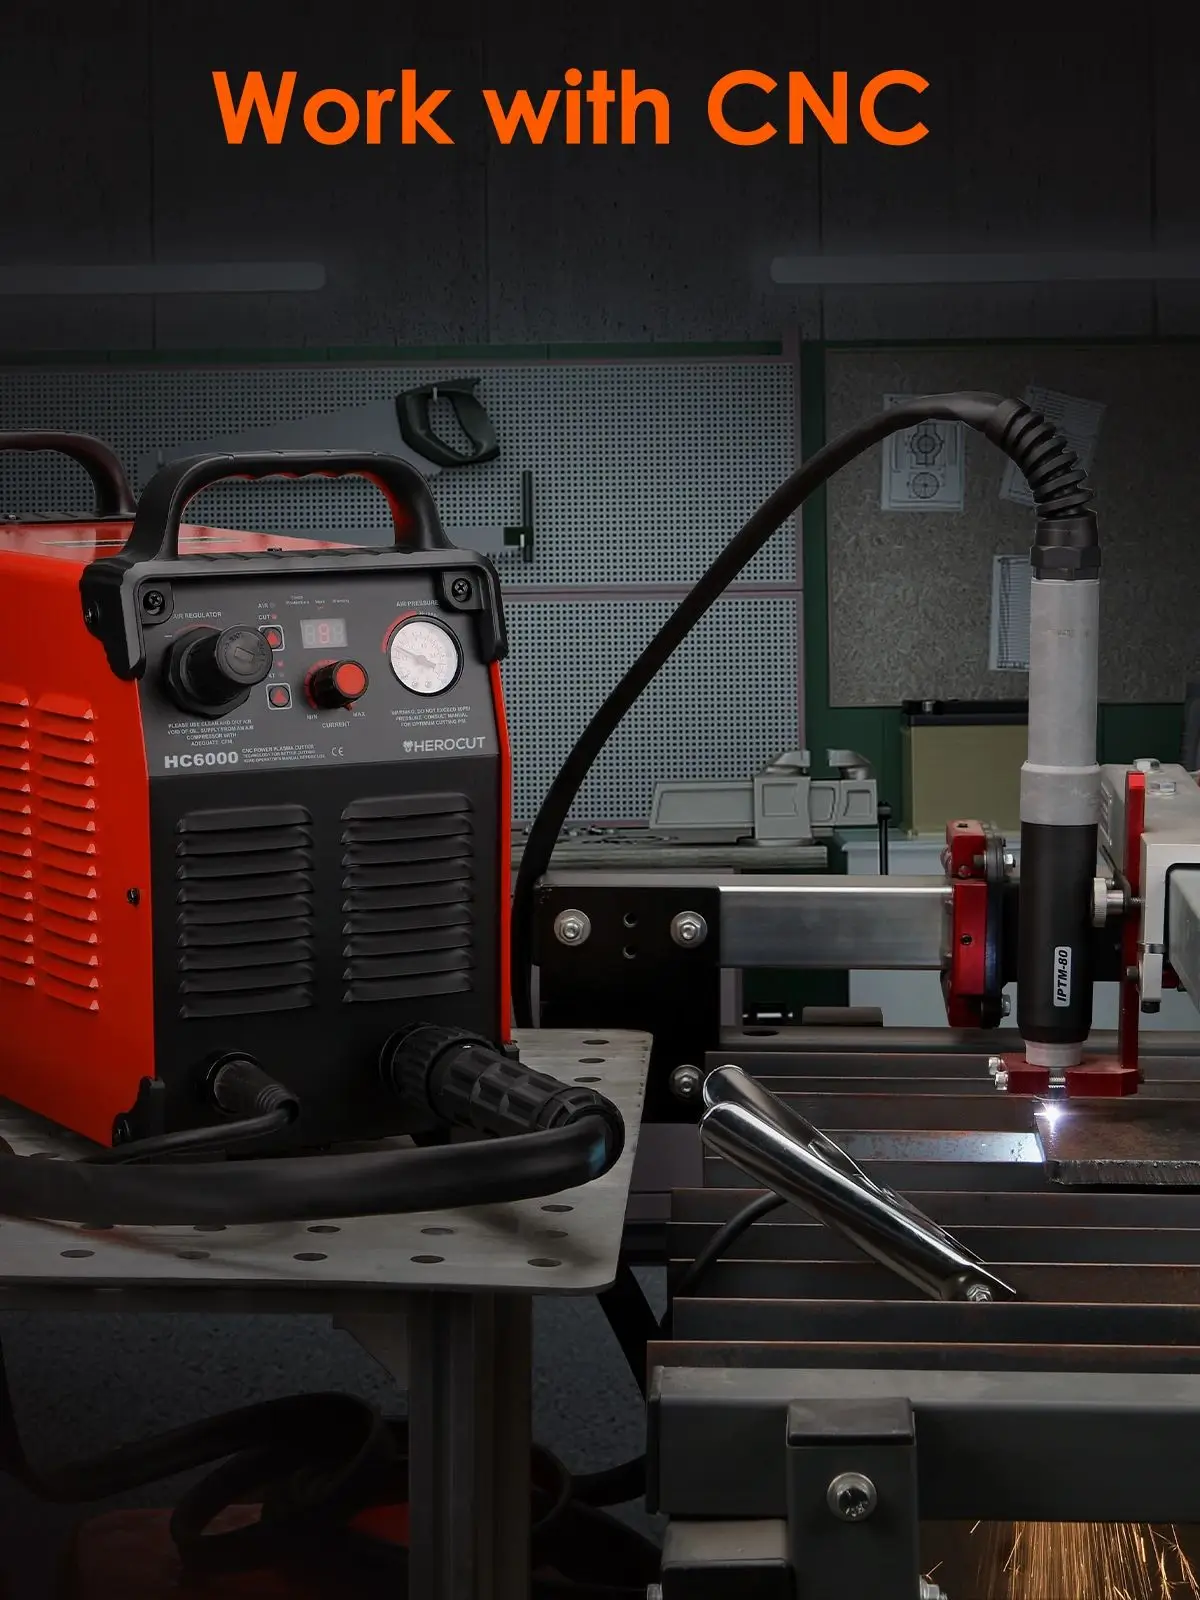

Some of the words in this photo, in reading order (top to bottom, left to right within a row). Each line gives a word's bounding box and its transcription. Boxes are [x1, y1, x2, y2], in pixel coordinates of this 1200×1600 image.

[407, 599, 439, 607] PRESSURE
[184, 611, 222, 619] REGULATOR
[322, 721, 351, 729] CURRENT
[414, 736, 486, 753] HEROCUT
[164, 751, 239, 769] HC6000
[1057, 949, 1068, 1002] IPTM-80
